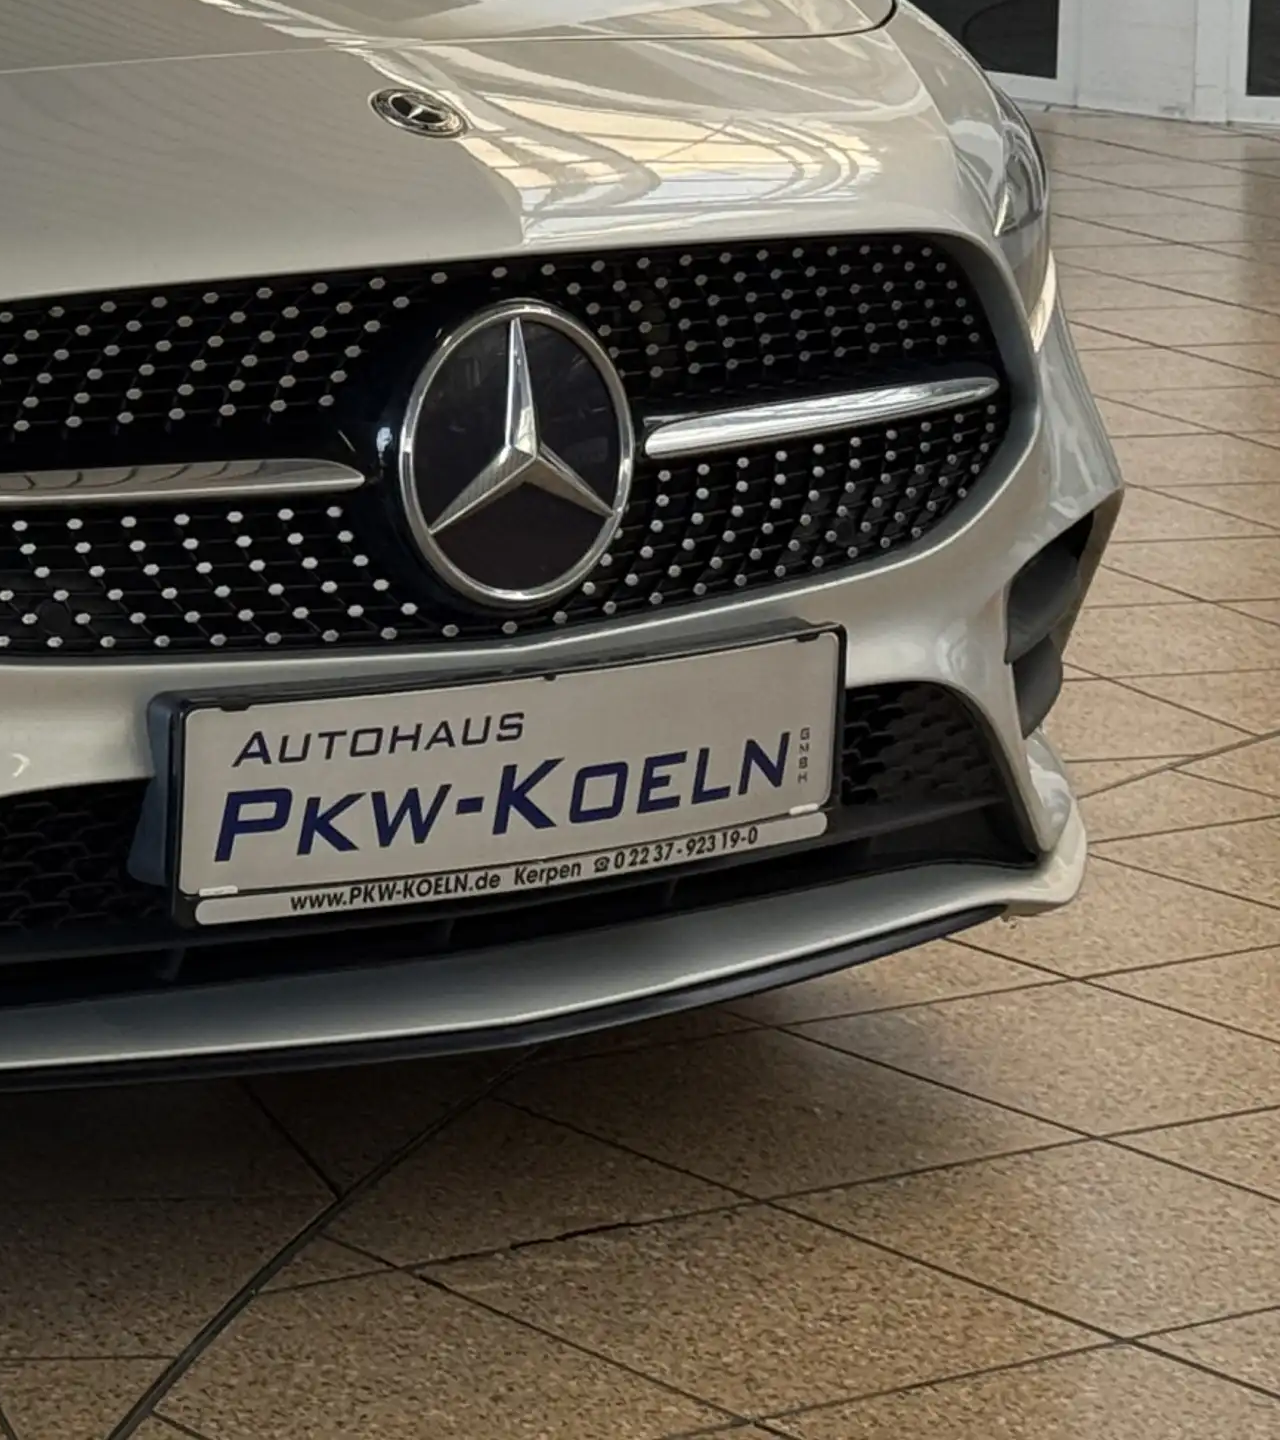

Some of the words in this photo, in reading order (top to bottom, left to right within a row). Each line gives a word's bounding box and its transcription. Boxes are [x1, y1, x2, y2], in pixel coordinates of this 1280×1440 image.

[233, 712, 525, 767] AUTOHAUS
[214, 732, 791, 863] PKW-KOELN
[290, 872, 501, 912] www.PKW-KOELN.de
[514, 862, 582, 885] Kerpen
